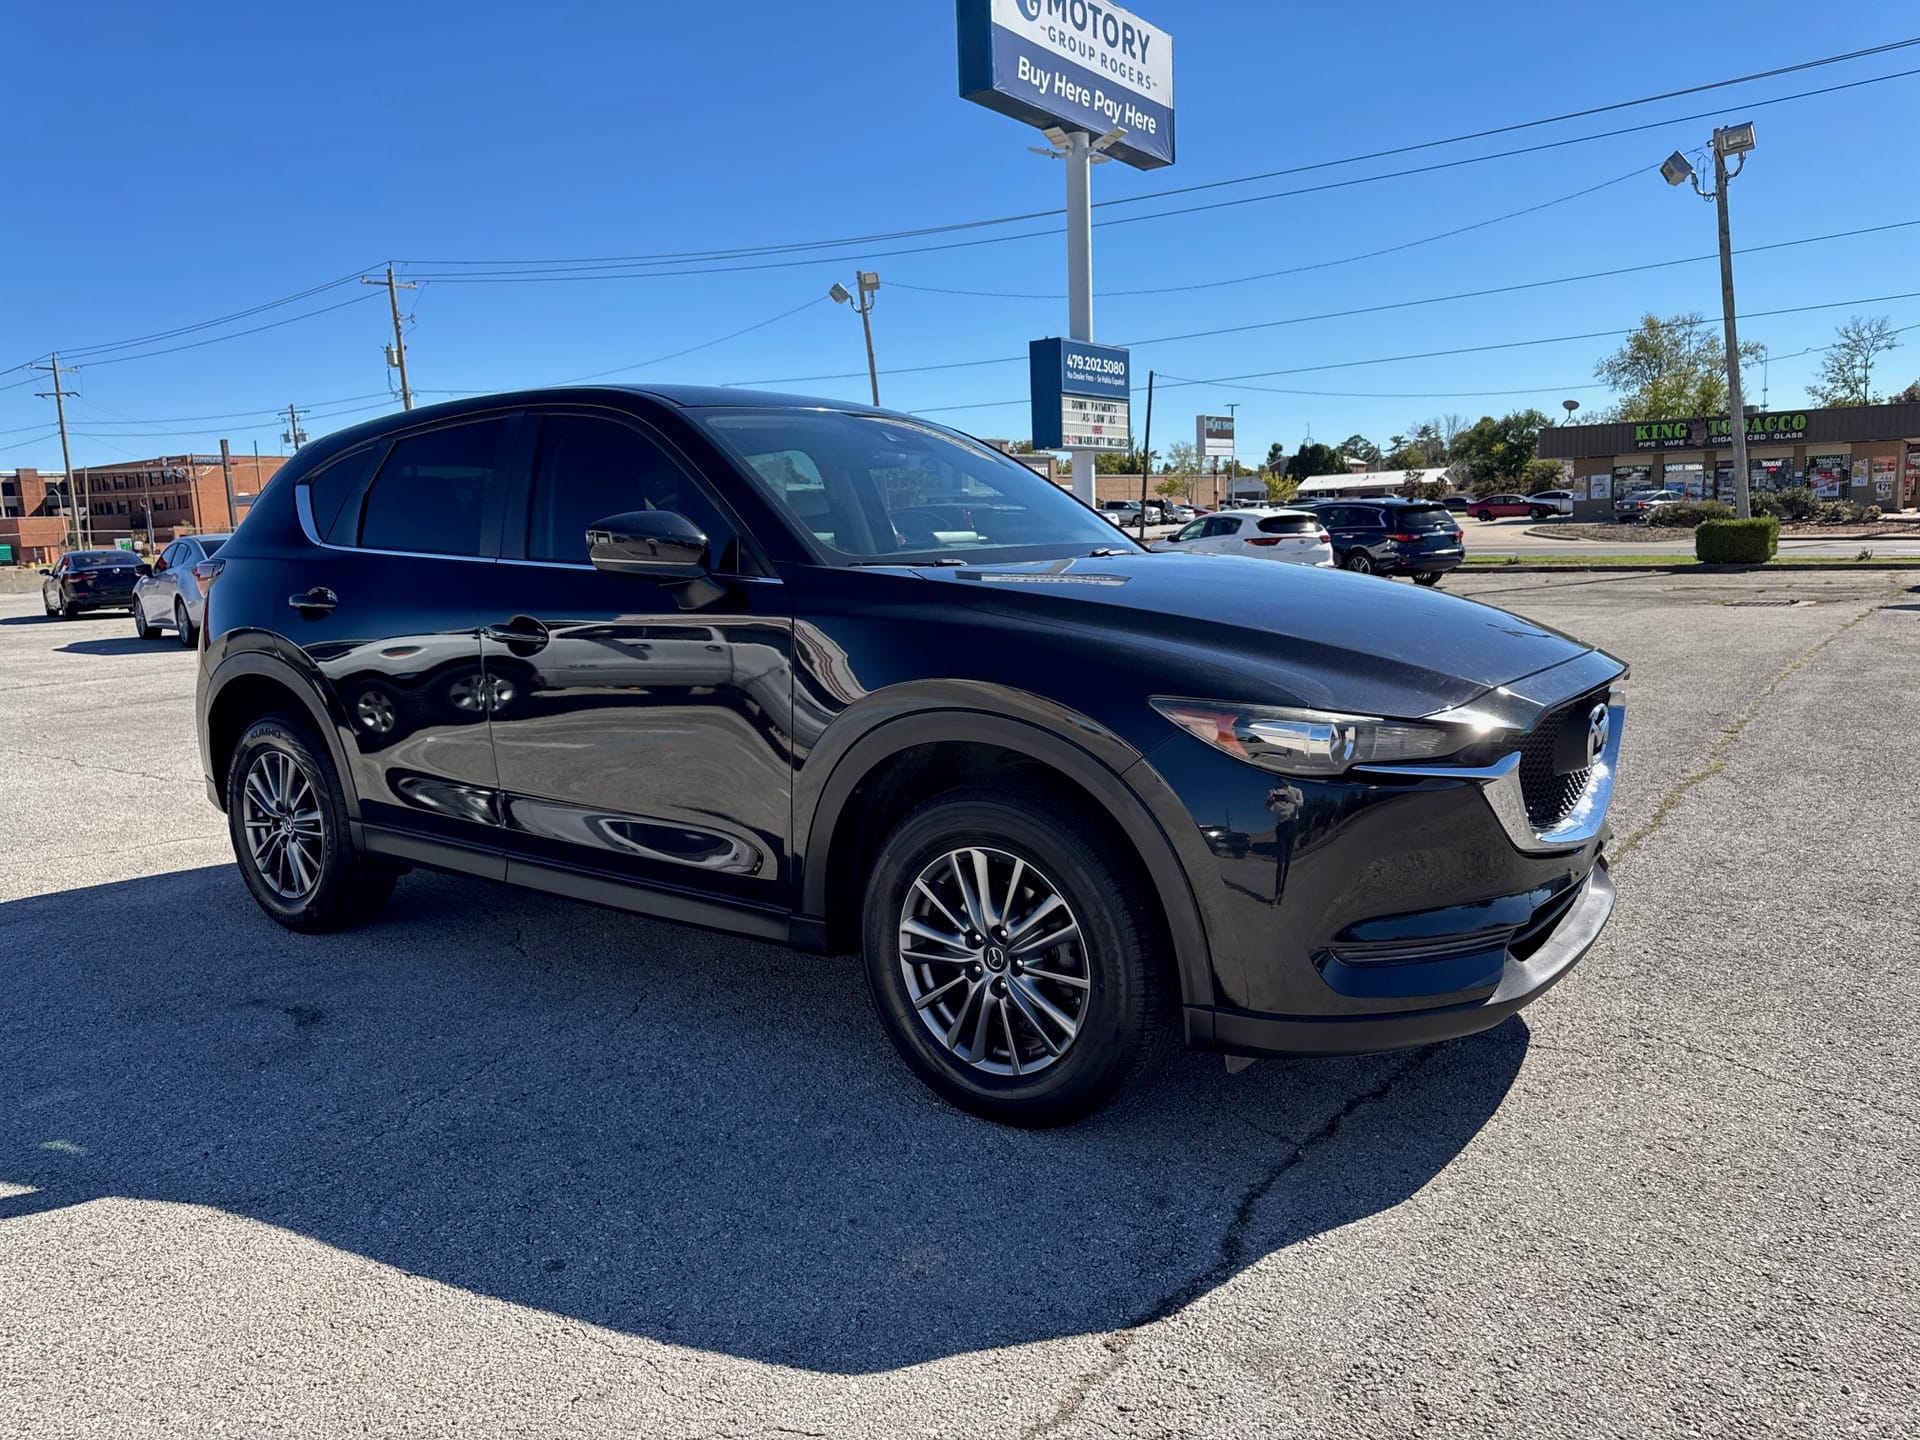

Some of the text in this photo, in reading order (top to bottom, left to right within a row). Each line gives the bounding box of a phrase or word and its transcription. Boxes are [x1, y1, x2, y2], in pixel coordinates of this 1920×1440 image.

[1047, 0, 1150, 65] MOTORY
[1018, 55, 1156, 134] Buy Here Pay Here
[1066, 353, 1125, 375] 479.202.5080
[1071, 400, 1117, 413] DOWN PAYMENTS
[1083, 413, 1116, 424] AS LOW AS
[1634, 422, 1688, 440] KING
[1638, 431, 1803, 449] PIPE VAPE CIGA CBD GLASS
[250, 727, 281, 742] KUMHO
